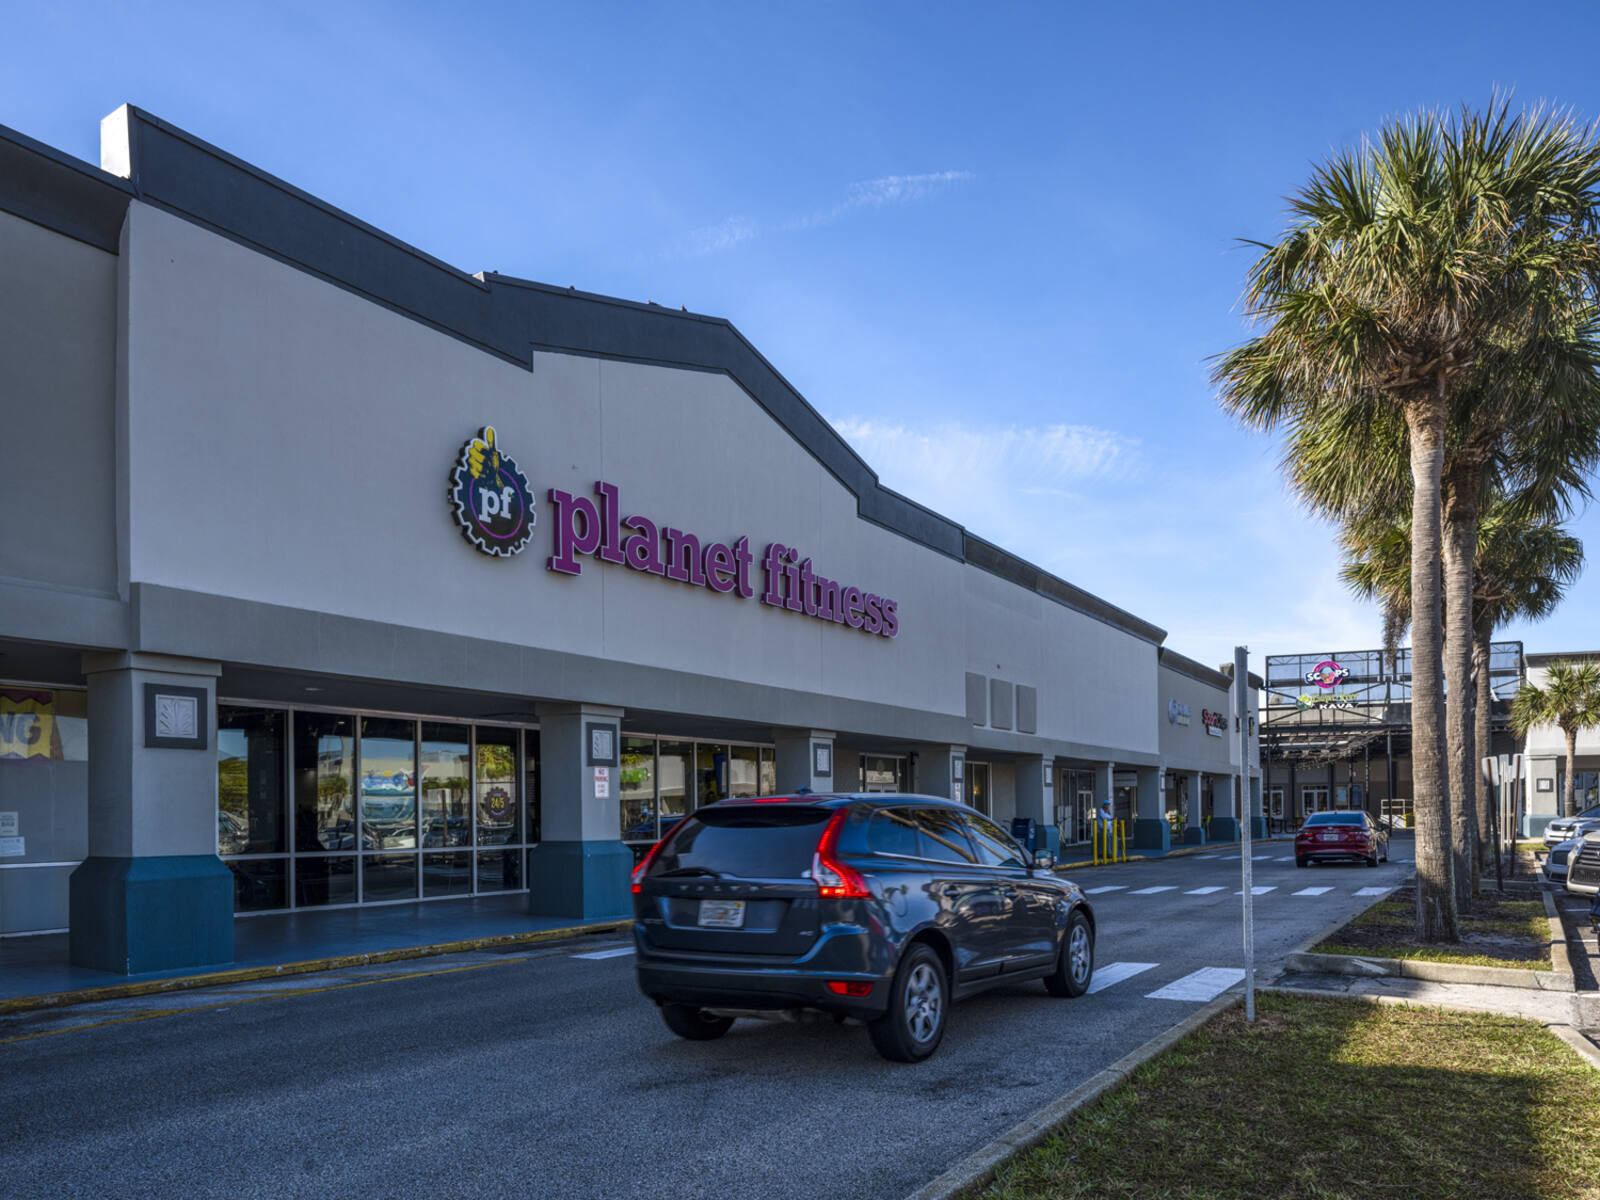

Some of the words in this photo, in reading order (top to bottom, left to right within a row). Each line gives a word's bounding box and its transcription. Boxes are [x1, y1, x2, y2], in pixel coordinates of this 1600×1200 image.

[478, 486, 515, 523] pf
[548, 480, 754, 599] planet
[761, 542, 899, 639] fitness
[1319, 702, 1354, 710] KAVA
